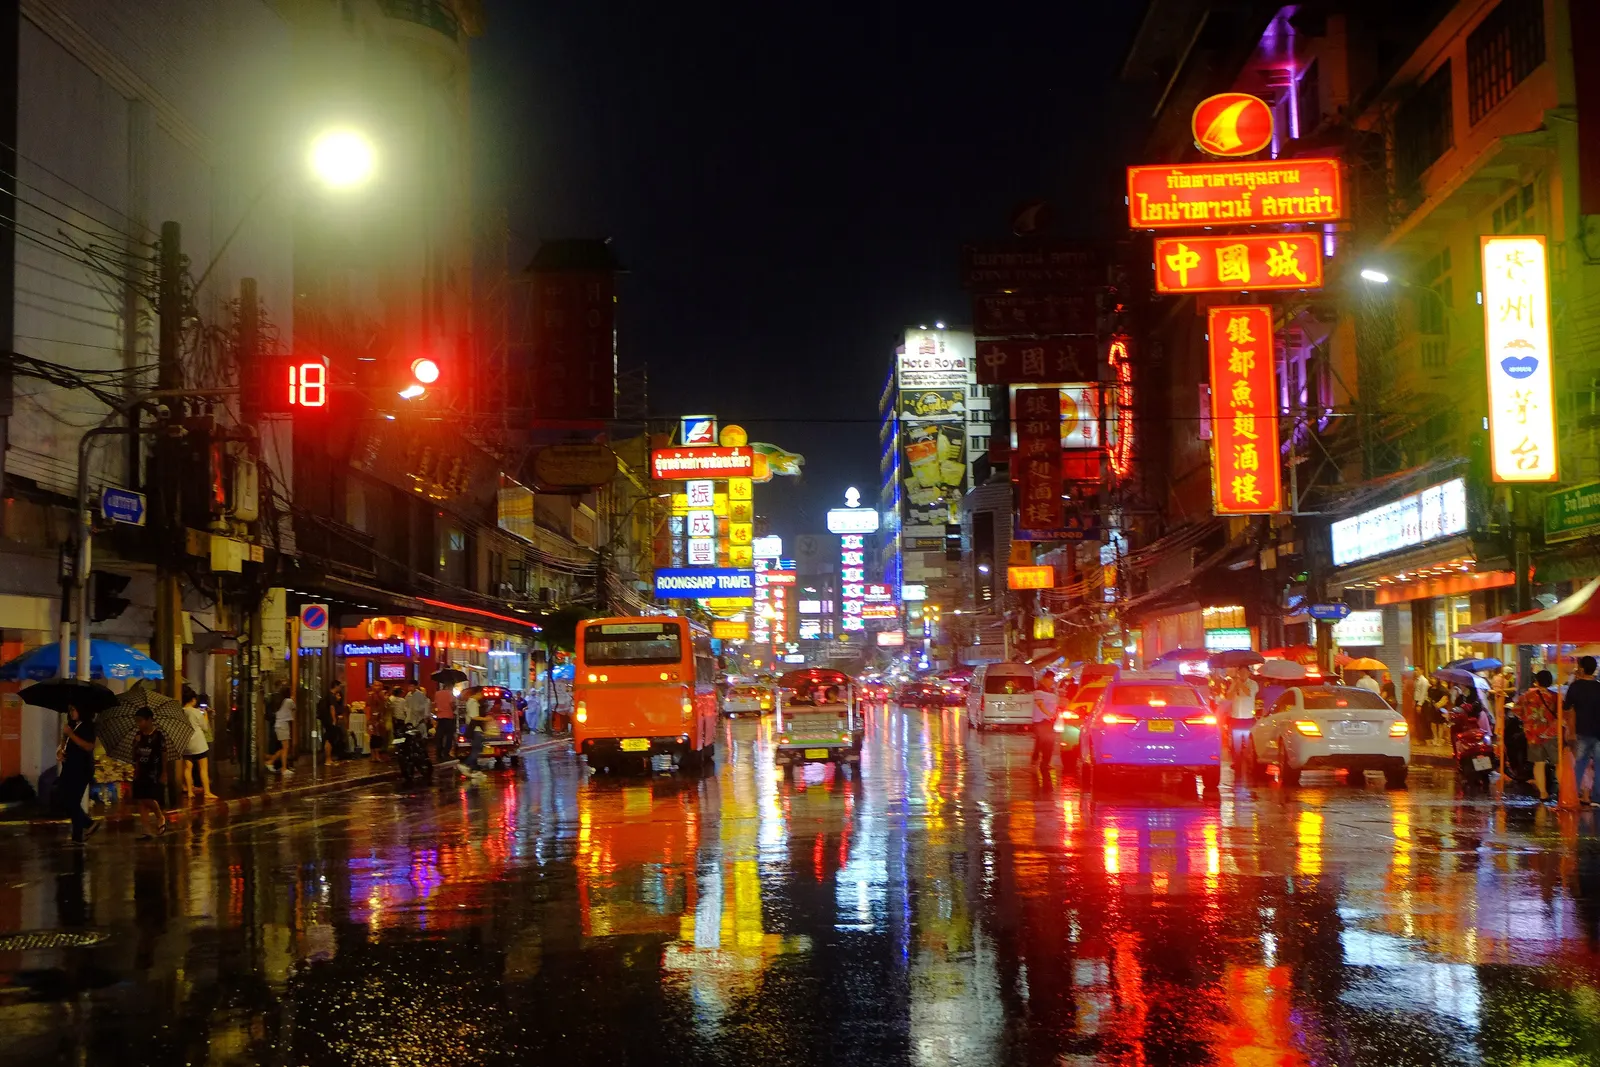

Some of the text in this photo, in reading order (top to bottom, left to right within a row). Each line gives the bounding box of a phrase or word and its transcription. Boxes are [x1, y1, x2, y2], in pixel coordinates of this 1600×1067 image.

[1137, 188, 1334, 221] ไชน่าทาวน์ สกาล่า
[1166, 241, 1307, 287] 中國城
[934, 358, 967, 370] Royal
[287, 363, 326, 408] 18
[657, 576, 716, 589] ROONGSARP
[717, 575, 753, 588] TRAVEL
[344, 642, 404, 655] Chinatown Hotel
